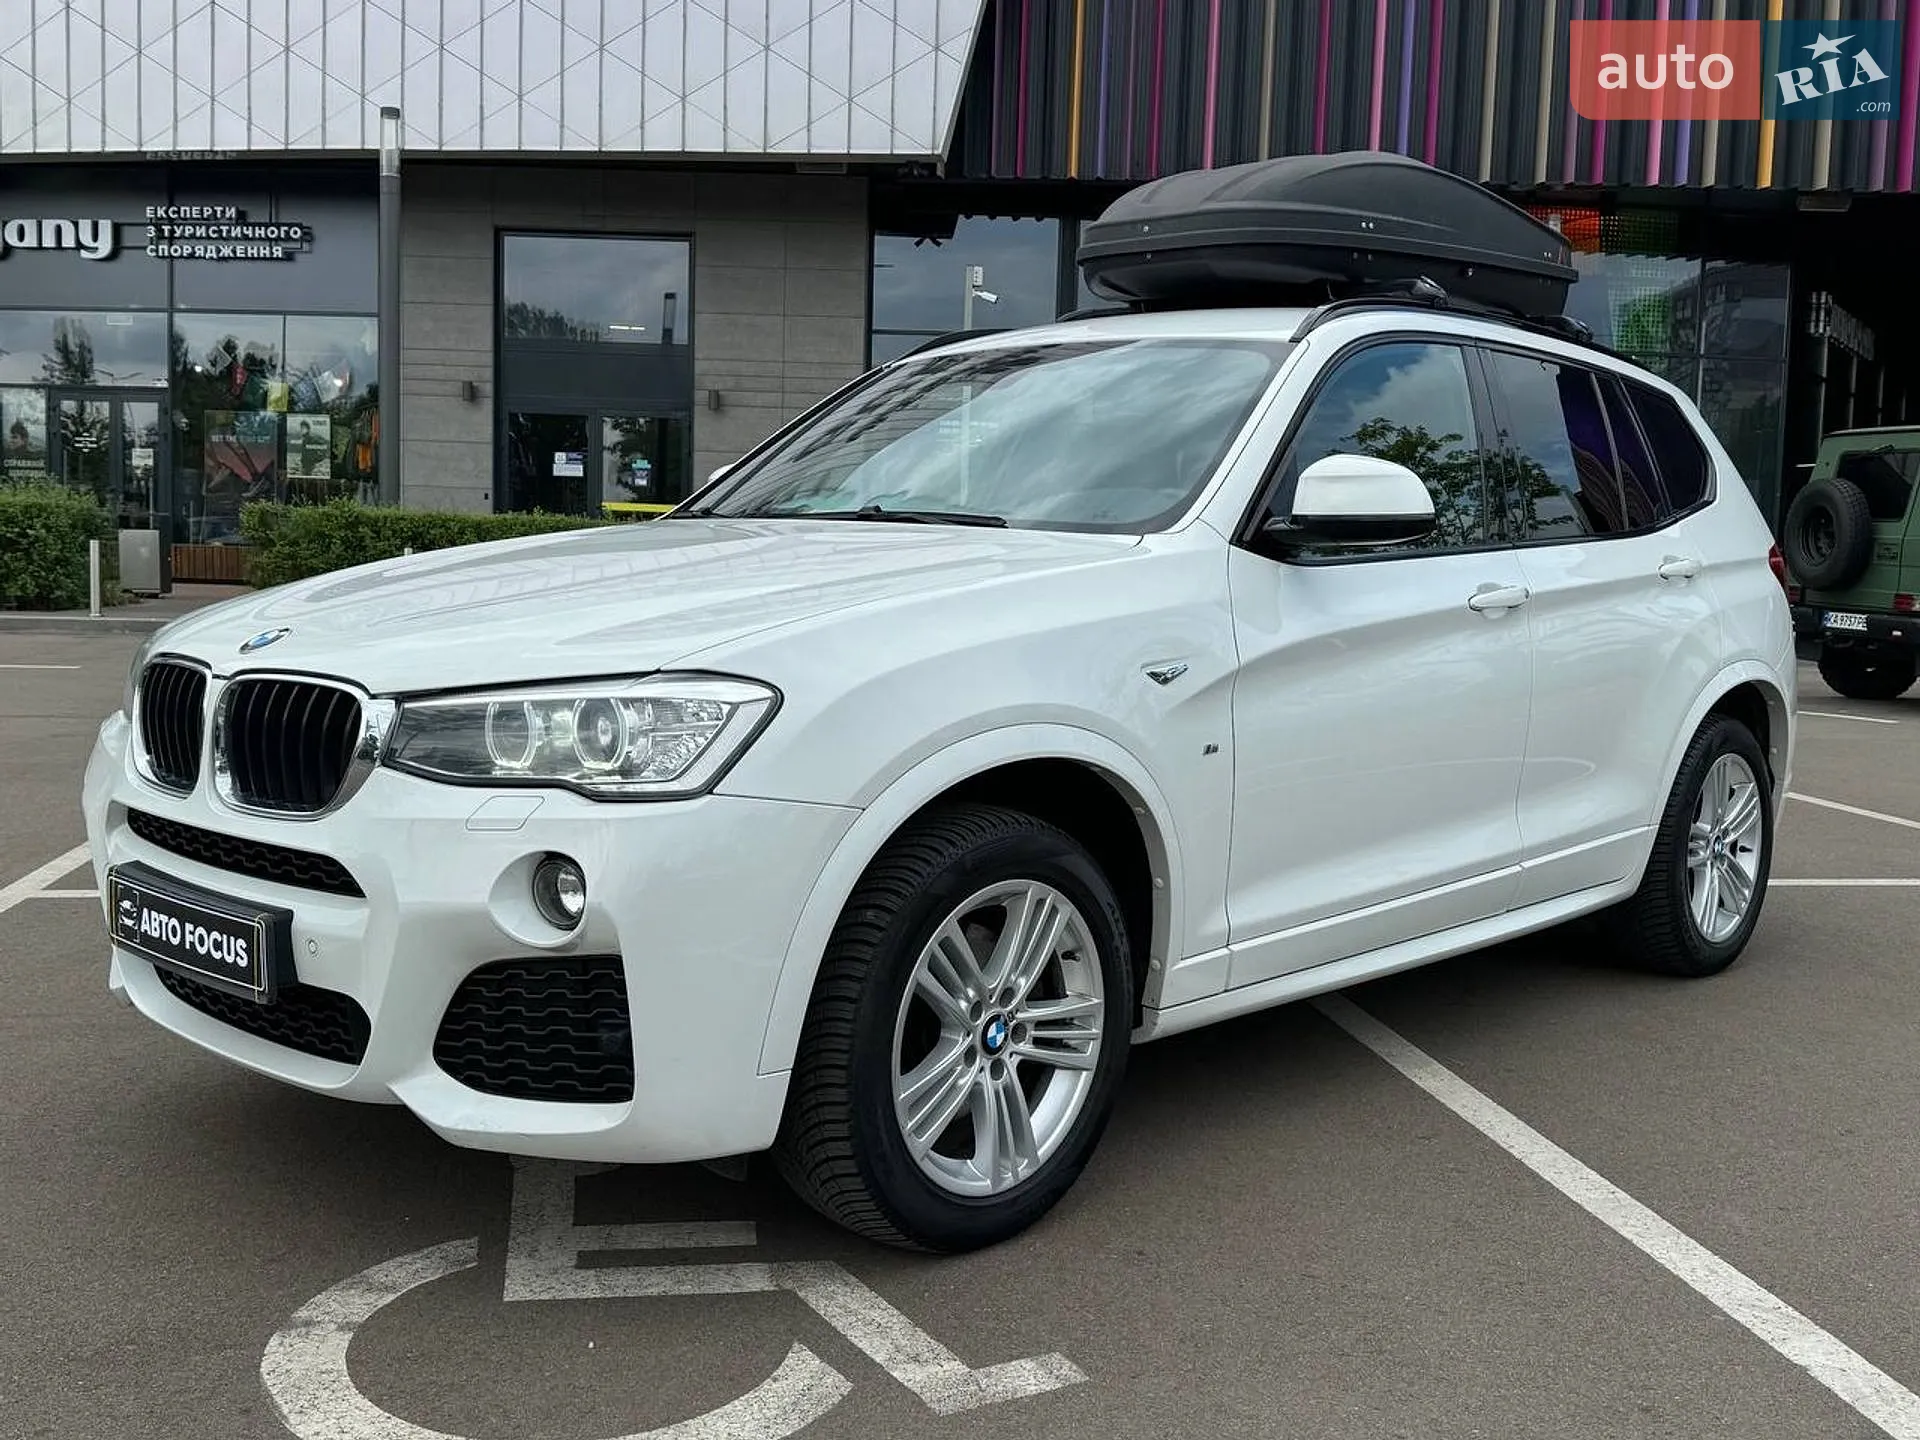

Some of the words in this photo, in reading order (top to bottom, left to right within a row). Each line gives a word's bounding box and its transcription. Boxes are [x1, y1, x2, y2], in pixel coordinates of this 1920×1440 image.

[146, 206, 236, 218] ЕКСПЕРТИ
[0, 218, 113, 260] any
[161, 225, 301, 239] ТУРИСТИЧНОГО
[146, 245, 283, 259] СПОРЯДЖЕННЯ
[185, 922, 248, 967] FOCUS
